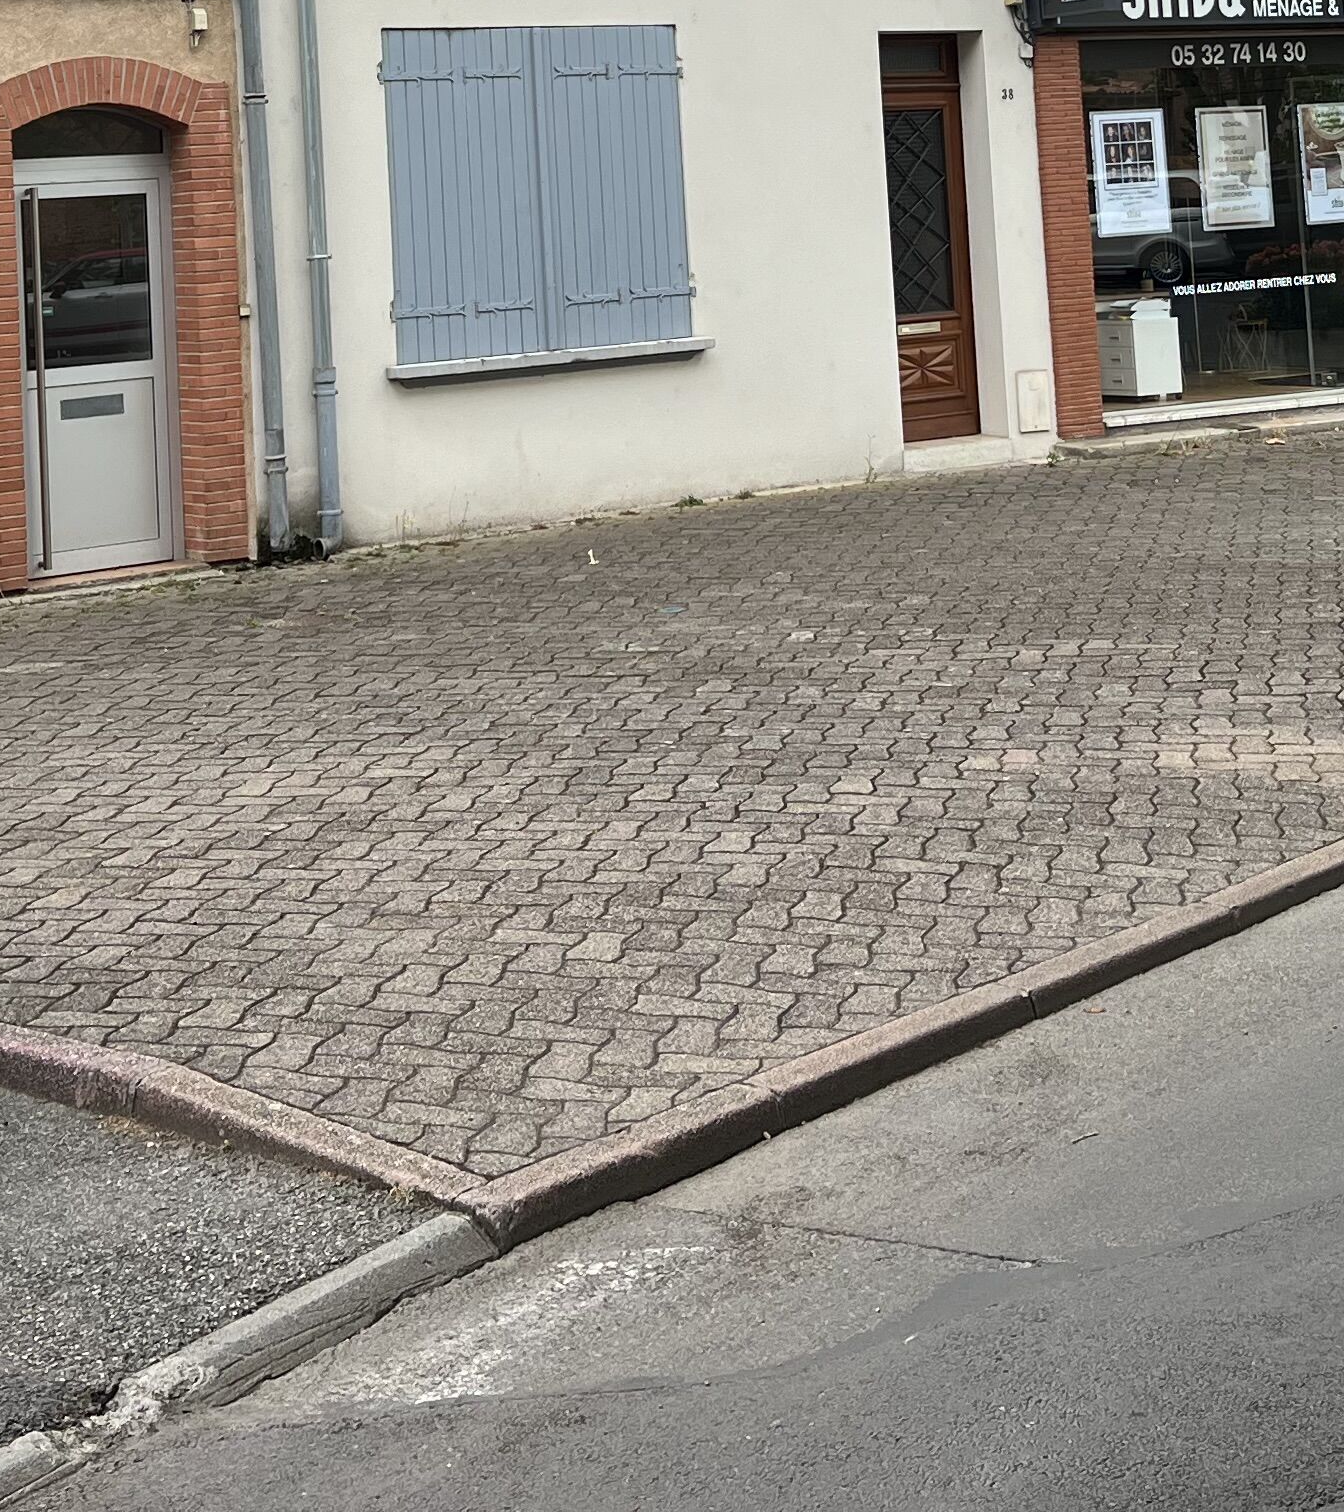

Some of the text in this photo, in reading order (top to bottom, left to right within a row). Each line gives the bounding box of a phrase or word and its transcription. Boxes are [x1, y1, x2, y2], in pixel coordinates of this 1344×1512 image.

[1171, 41, 1306, 66] 05 32 74 14 30
[1002, 88, 1014, 100] 38
[1172, 272, 1337, 296] VOUS ALLEZ ADORER RENTRER CHEZ VOUS
